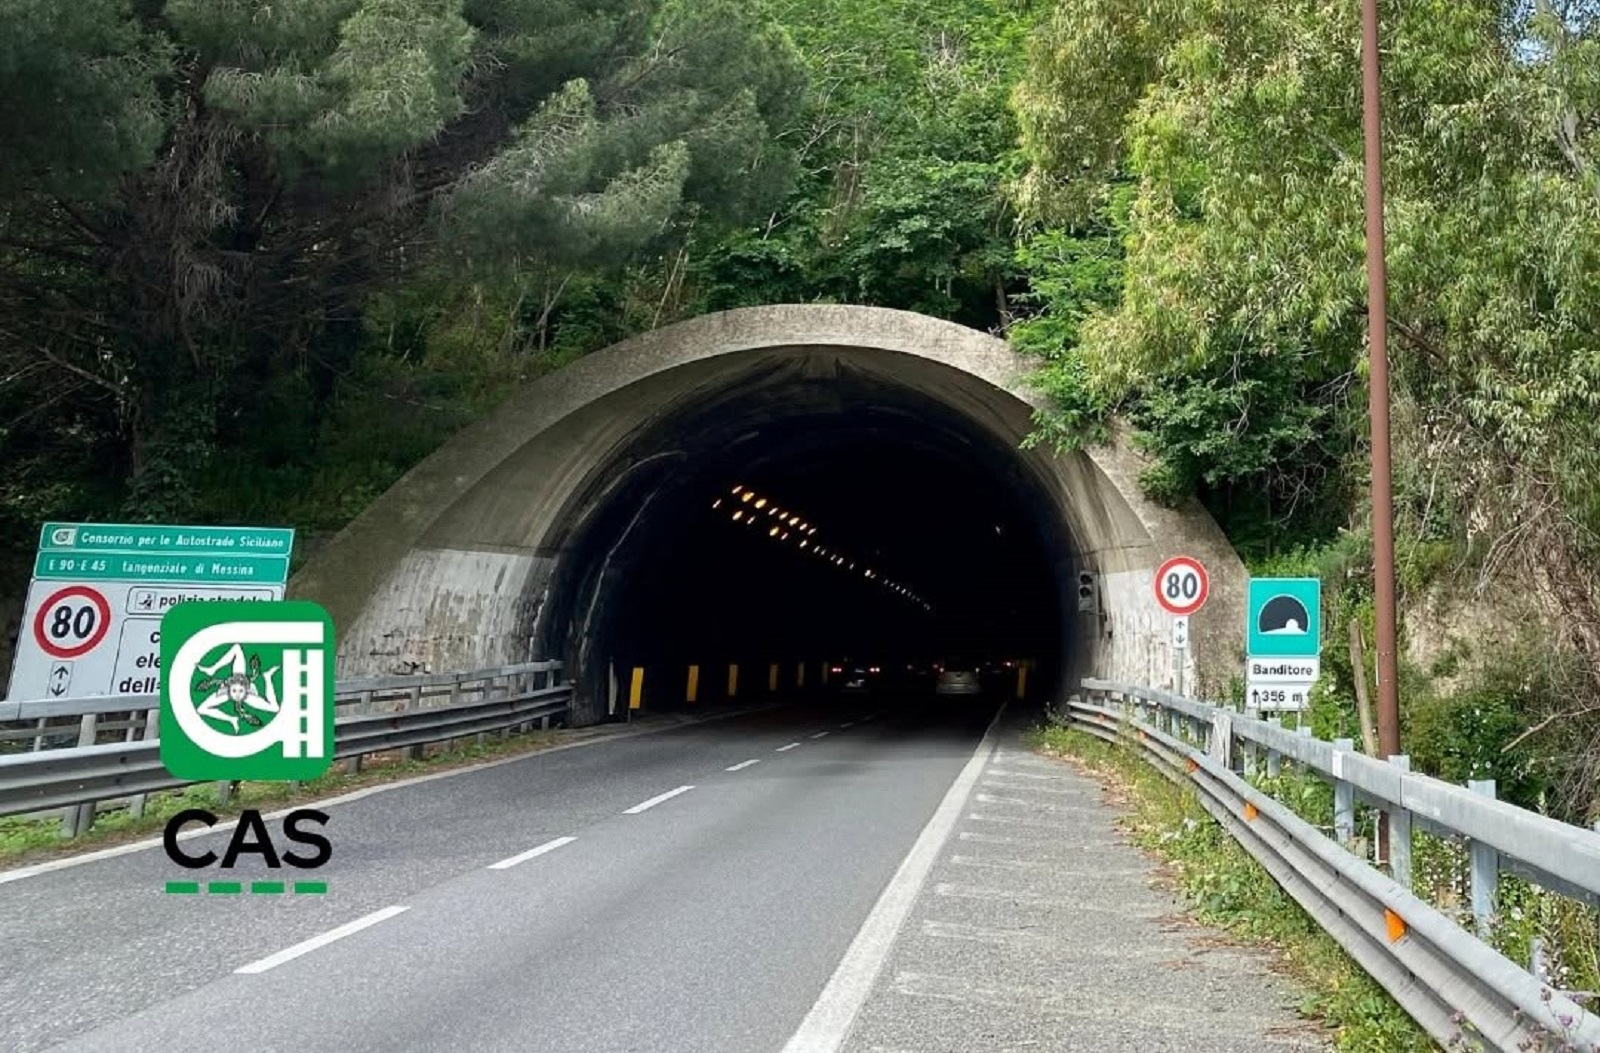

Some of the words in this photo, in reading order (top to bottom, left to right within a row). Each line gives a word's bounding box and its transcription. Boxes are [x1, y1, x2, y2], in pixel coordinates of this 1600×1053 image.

[81, 532, 134, 545] Consorzio
[137, 536, 157, 547] per
[160, 535, 171, 545] le
[175, 534, 235, 547] Autostrade
[239, 535, 284, 547] Siciliane
[91, 560, 107, 571] 45
[122, 561, 187, 575] tangenziale
[195, 563, 204, 574] di
[211, 563, 254, 575] Messina
[1166, 572, 1198, 599] 80
[51, 605, 95, 638] 80
[1252, 664, 1313, 676] Banditore
[1261, 690, 1285, 702] 356
[1292, 692, 1303, 703] m
